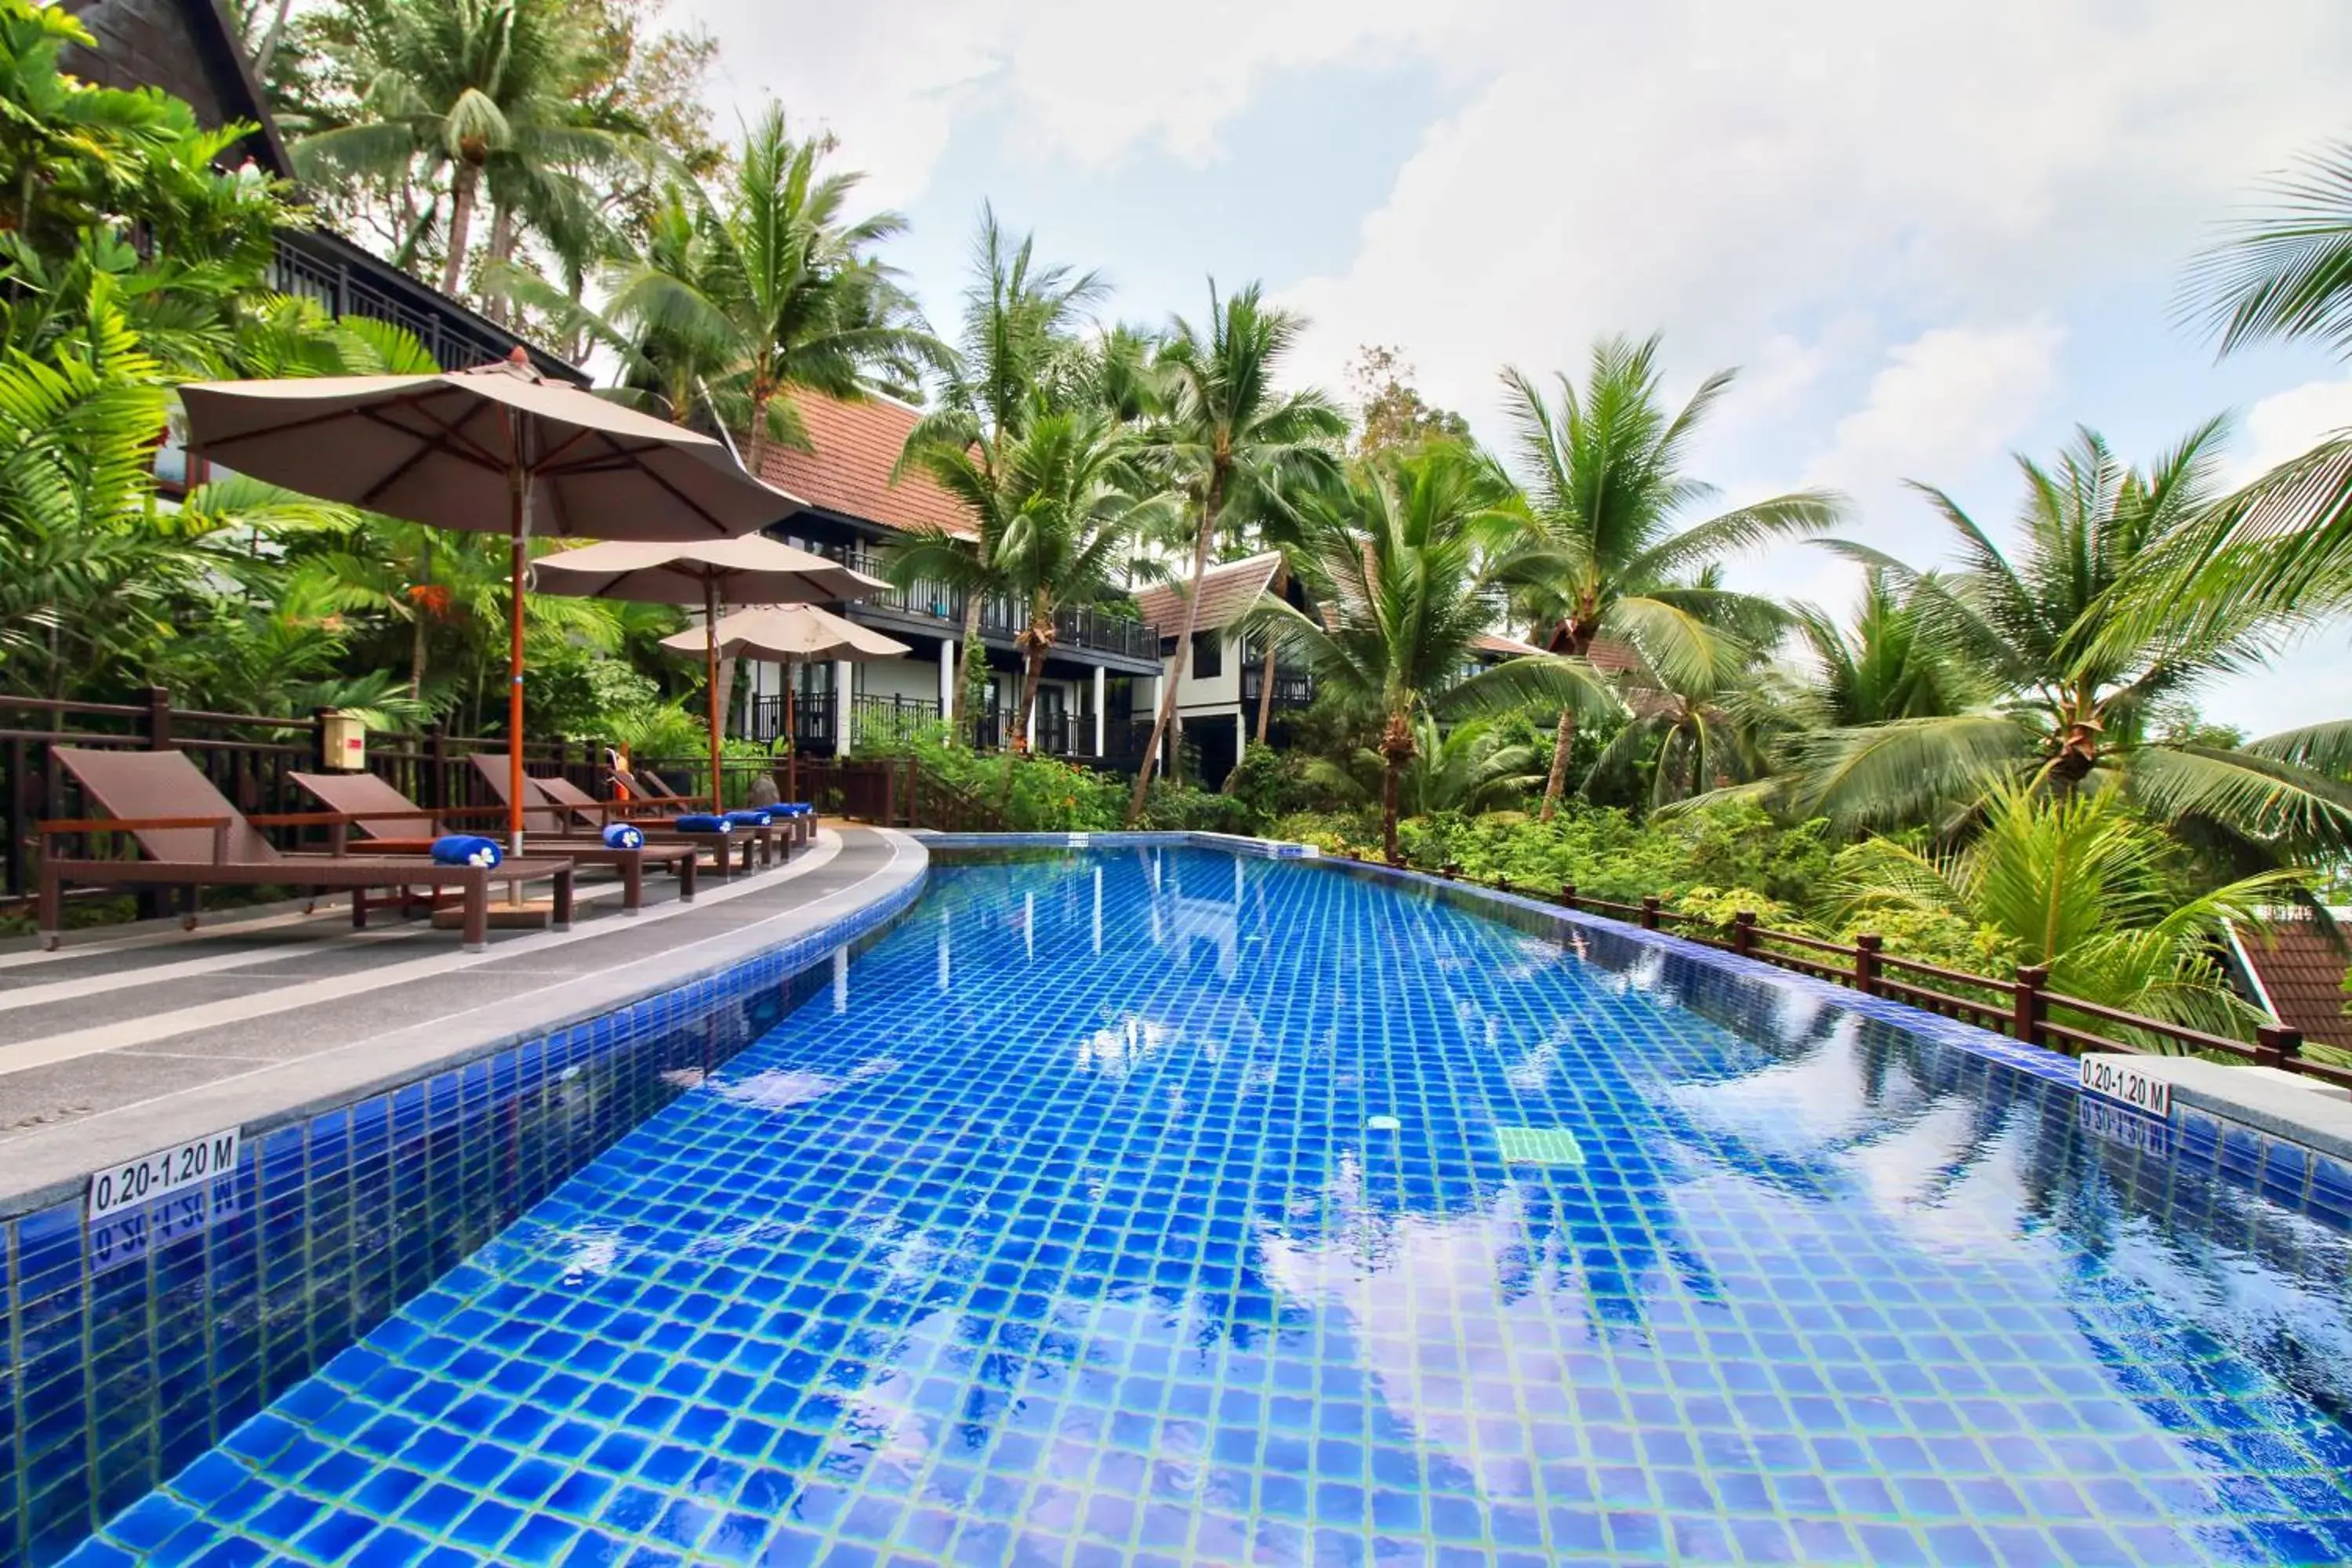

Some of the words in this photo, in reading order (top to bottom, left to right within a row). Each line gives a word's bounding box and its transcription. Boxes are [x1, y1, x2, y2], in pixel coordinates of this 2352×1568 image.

[2083, 1059, 2145, 1105] 0.20-1.20
[2151, 1082, 2163, 1112] M
[97, 1142, 208, 1211] 0.20-1.20
[214, 1136, 233, 1171] M
